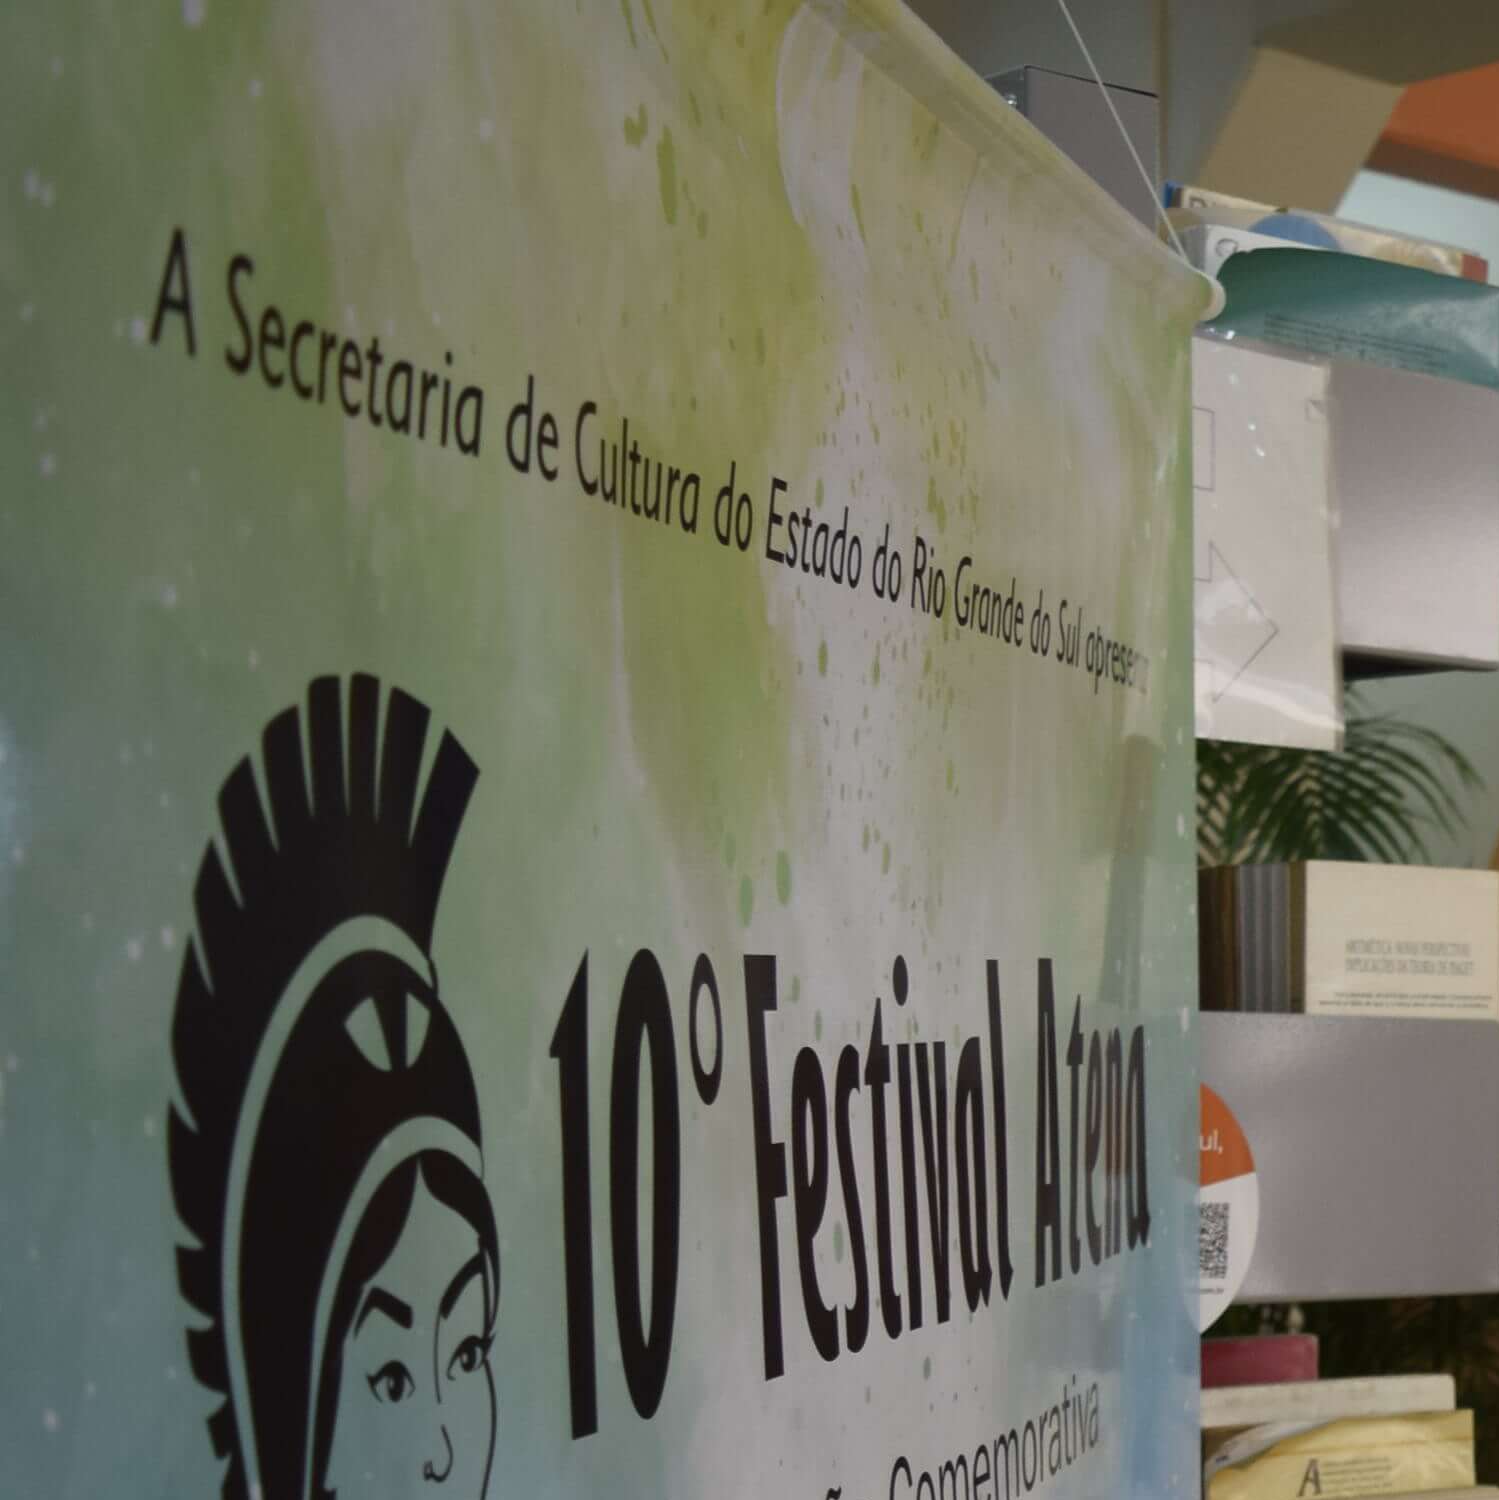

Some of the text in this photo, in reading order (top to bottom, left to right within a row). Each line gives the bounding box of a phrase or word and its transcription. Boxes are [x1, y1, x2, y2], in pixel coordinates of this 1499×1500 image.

[149, 227, 196, 357] A
[223, 253, 484, 458] Secretaria
[505, 373, 559, 482] de
[574, 400, 701, 534] Cultura
[713, 460, 753, 552] do
[764, 476, 862, 589] Estado
[871, 523, 902, 603] do
[910, 535, 946, 619] Rio
[954, 555, 1025, 648] Grande
[1030, 589, 1051, 657] do
[1055, 598, 1083, 668] Sul
[743, 954, 1015, 1382] Festival
[1034, 956, 1152, 1289] Atena
